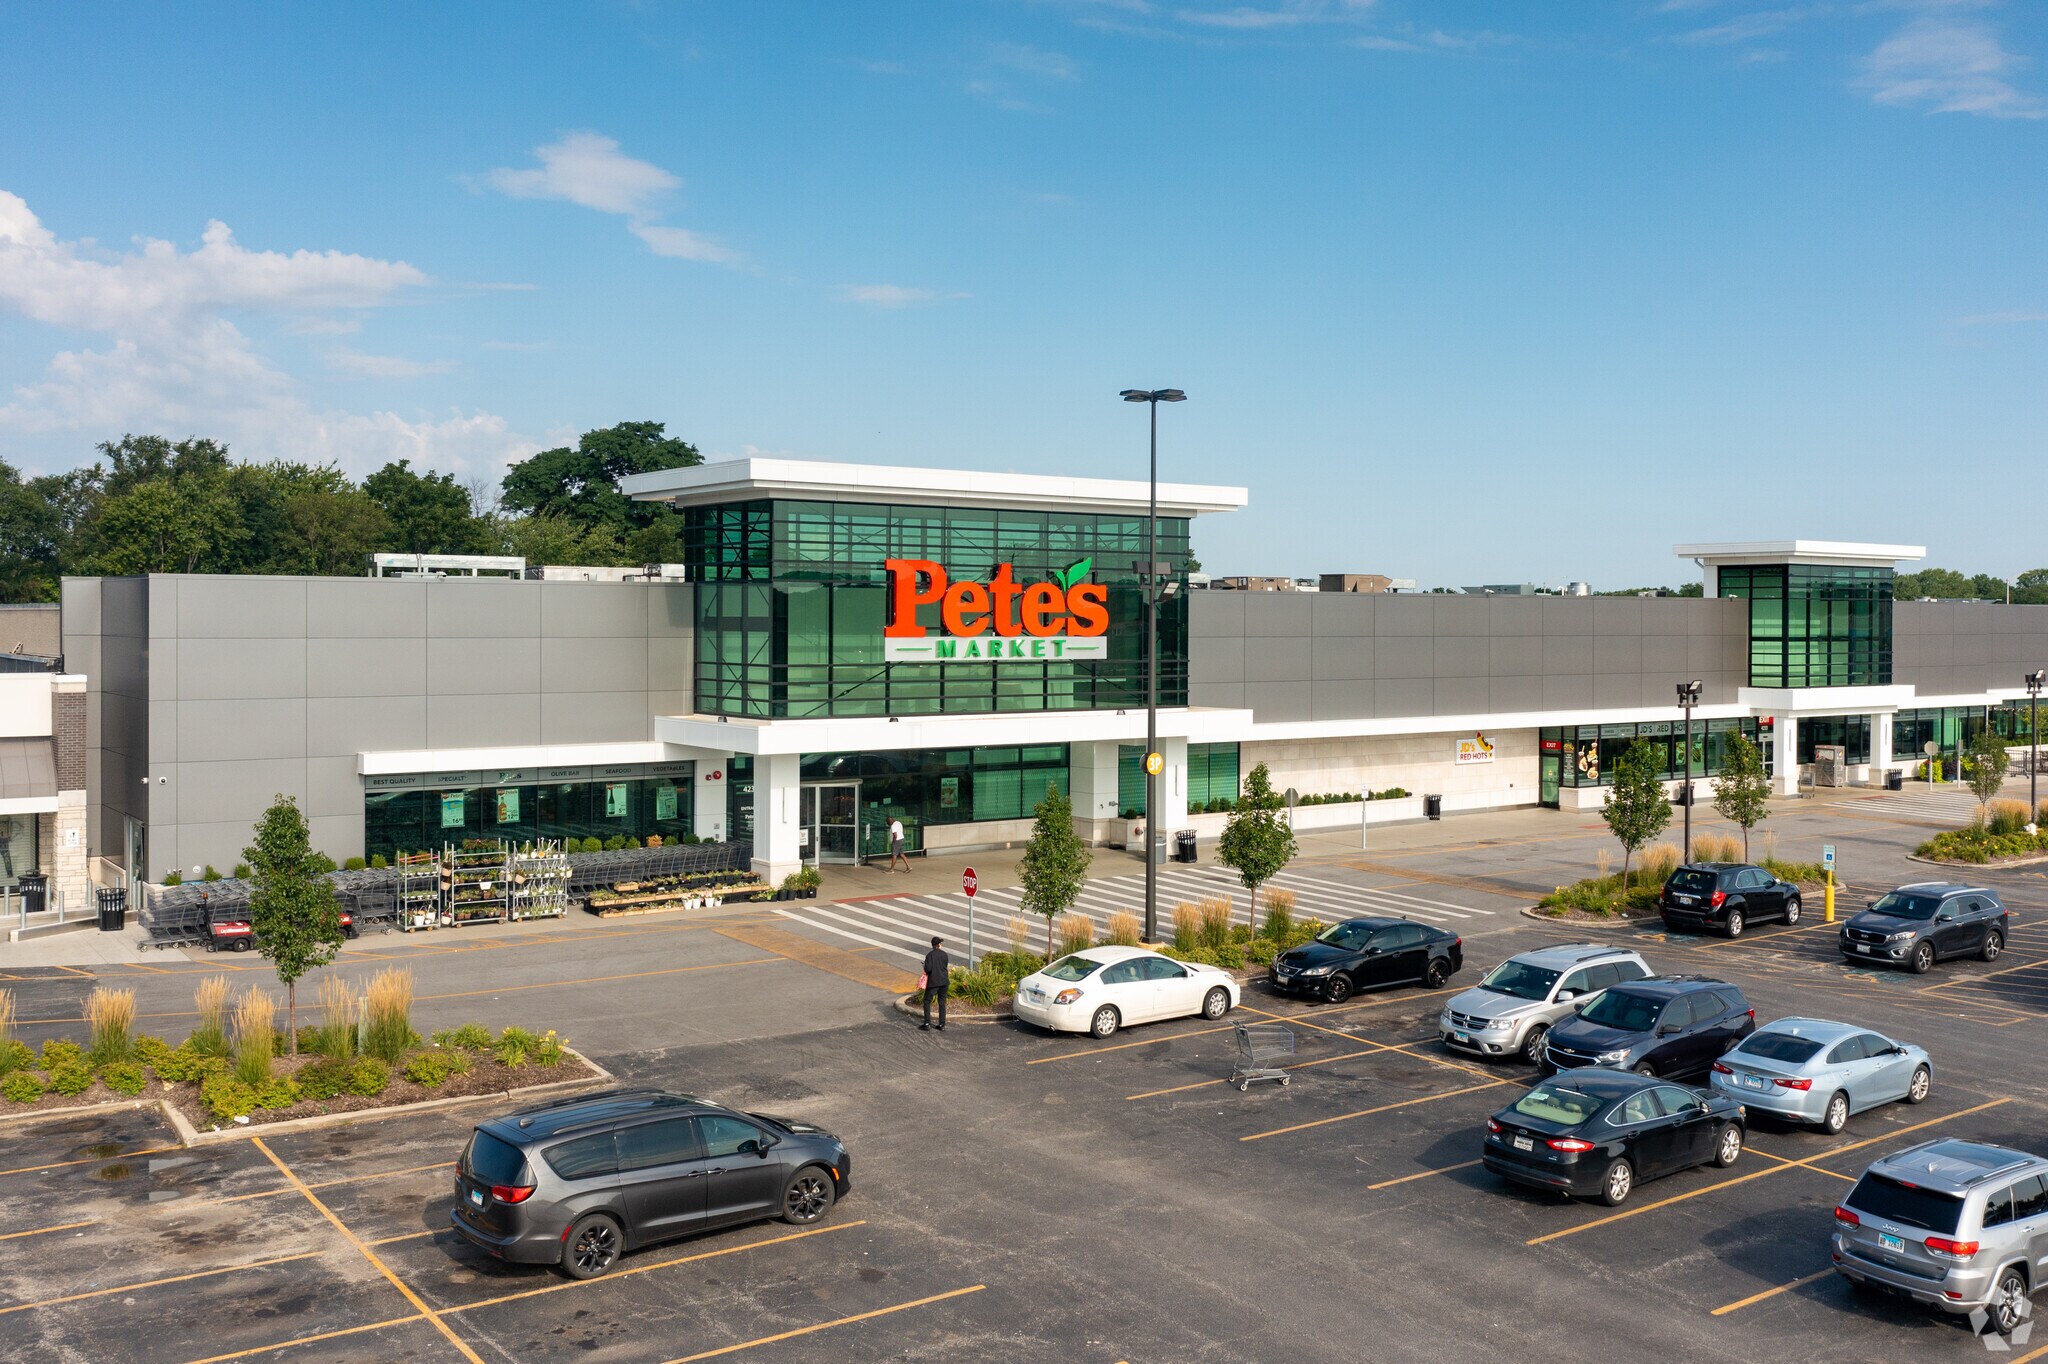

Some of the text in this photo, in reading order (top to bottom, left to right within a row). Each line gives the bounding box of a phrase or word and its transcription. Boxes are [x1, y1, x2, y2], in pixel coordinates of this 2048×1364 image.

[935, 639, 1067, 659] MARKET
[1656, 724, 1669, 733] RED
[1460, 742, 1475, 753] JD's
[1473, 752, 1488, 760] HOTS
[1150, 757, 1160, 771] 3P
[963, 875, 976, 889] STOP
